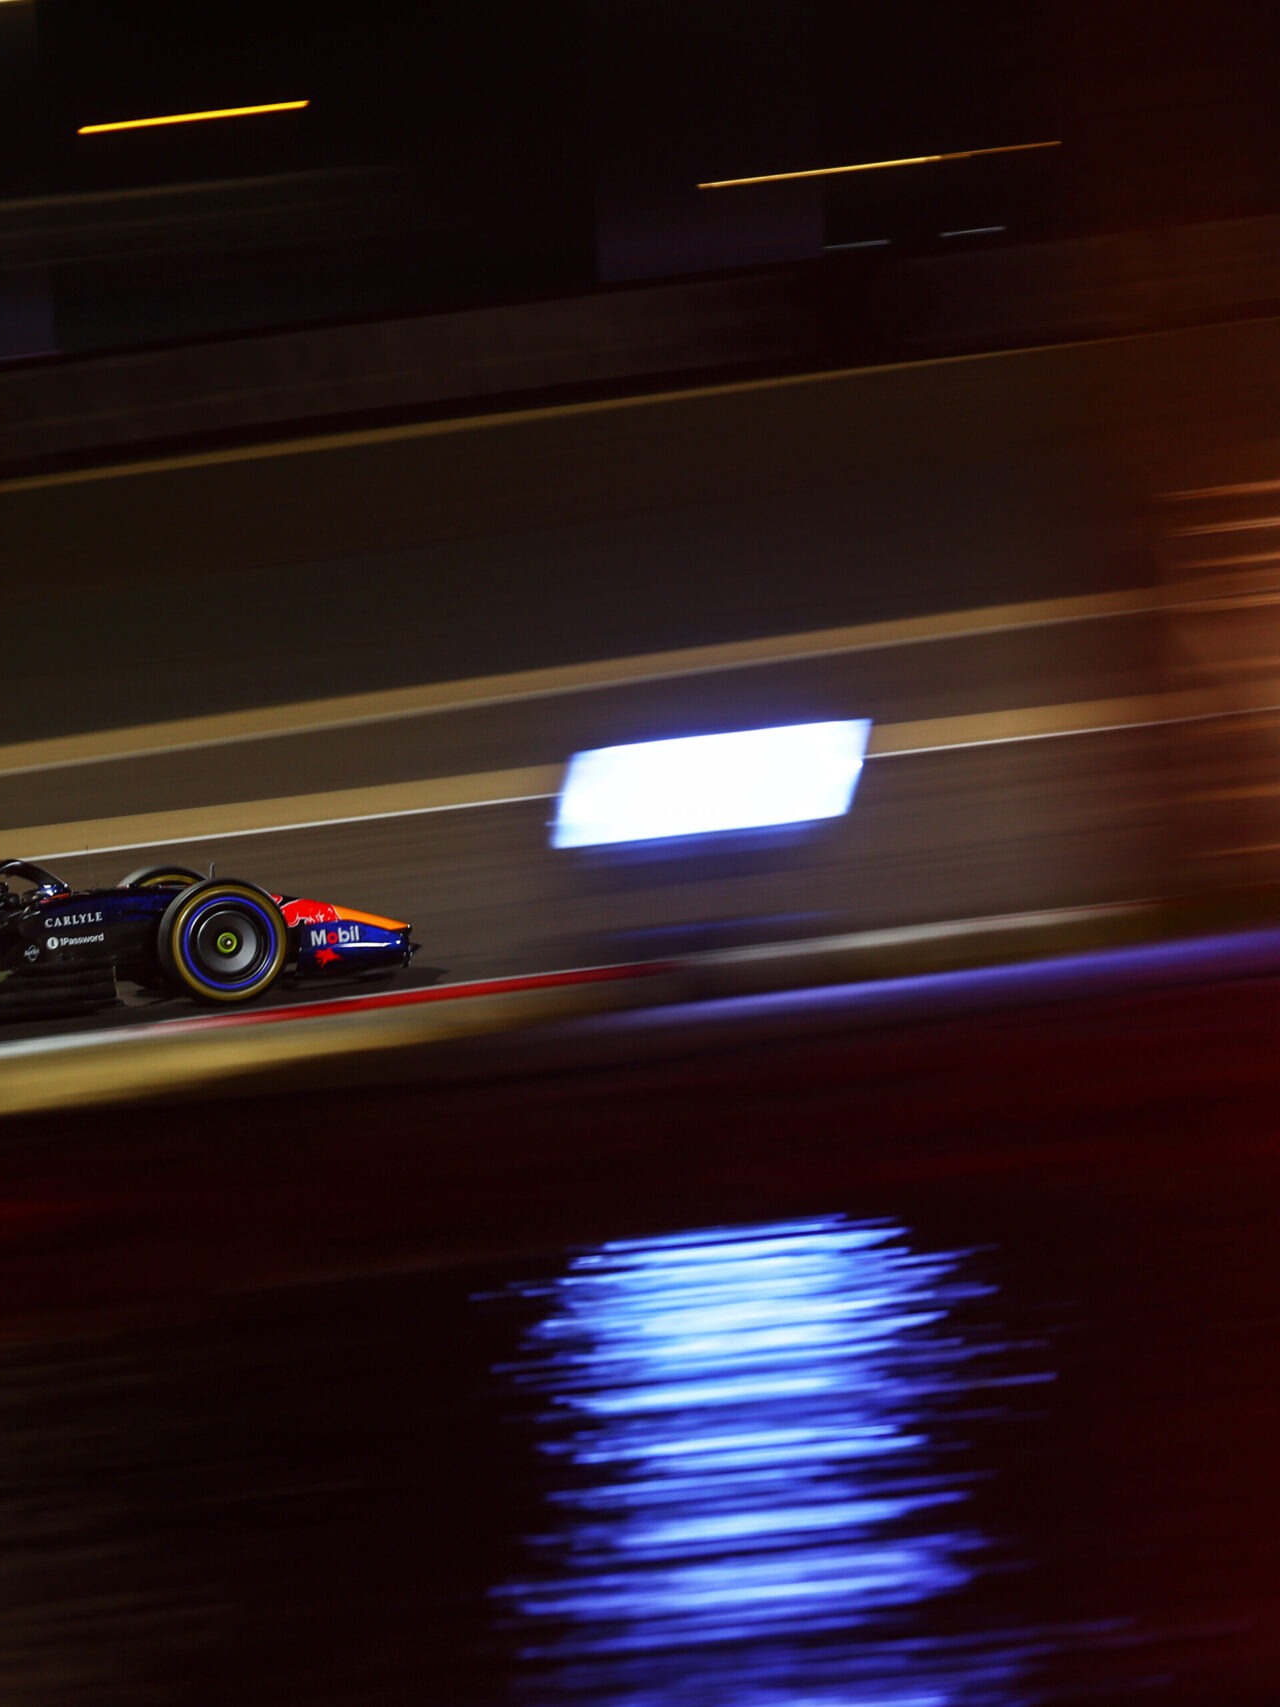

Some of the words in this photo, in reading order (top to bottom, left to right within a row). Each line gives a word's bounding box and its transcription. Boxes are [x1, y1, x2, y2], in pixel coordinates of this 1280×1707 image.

[44, 911, 104, 929] CARLYLE
[60, 932, 105, 948] 1Password
[310, 924, 360, 948] Mobil
